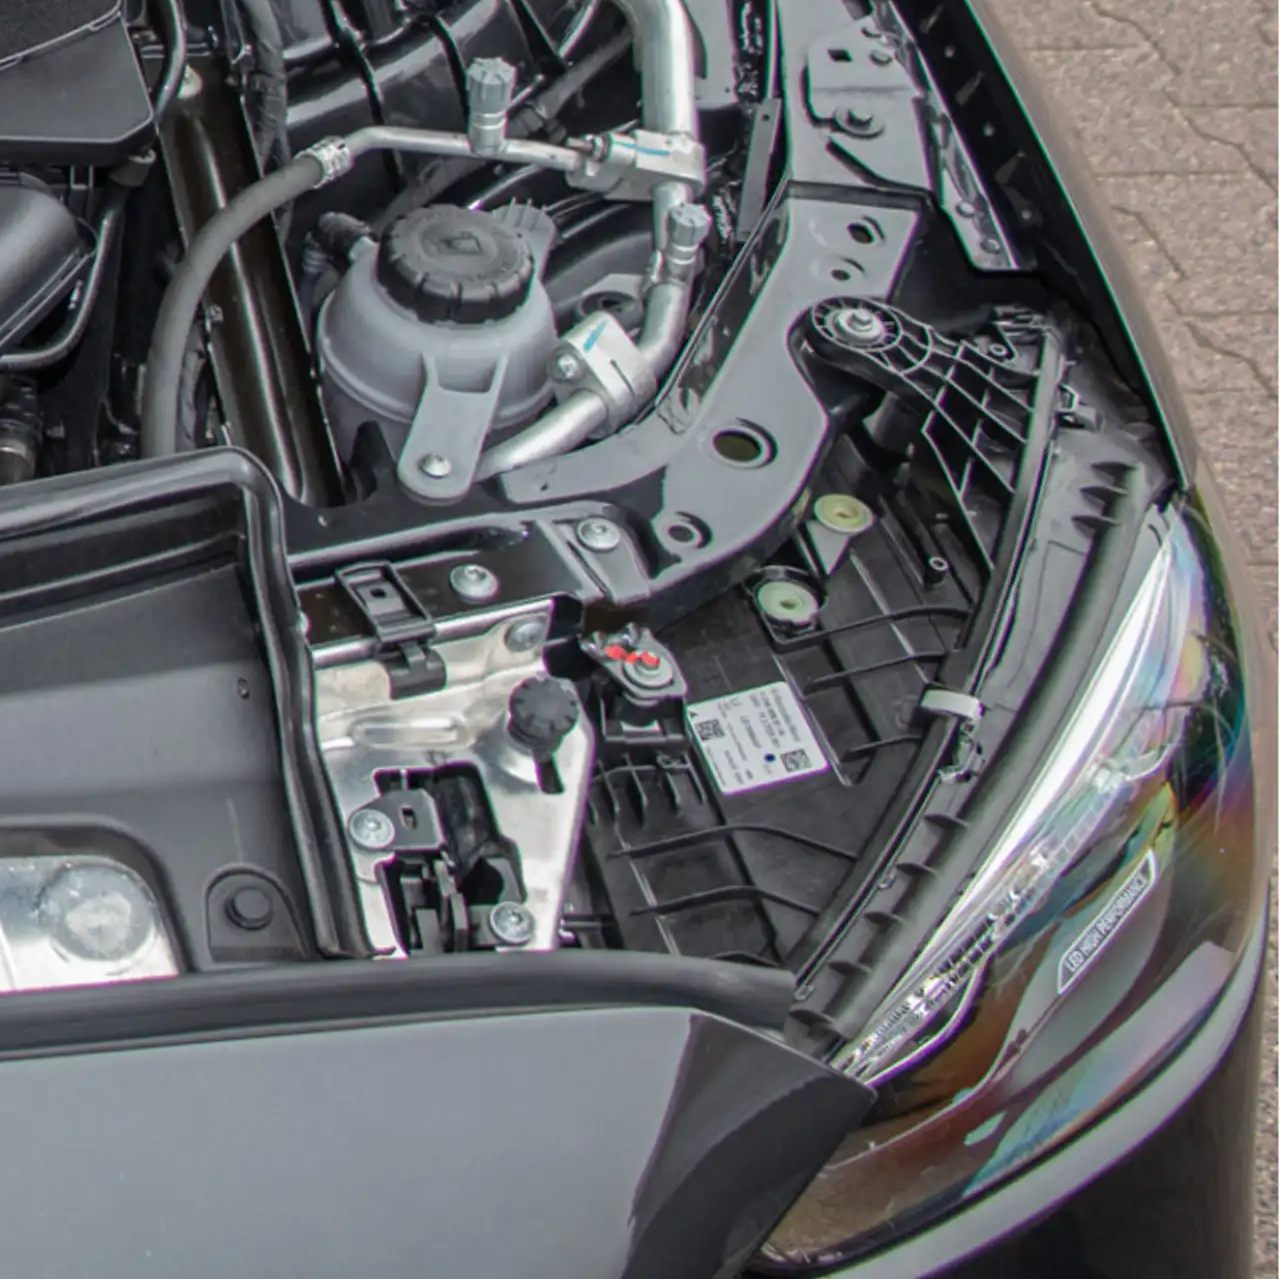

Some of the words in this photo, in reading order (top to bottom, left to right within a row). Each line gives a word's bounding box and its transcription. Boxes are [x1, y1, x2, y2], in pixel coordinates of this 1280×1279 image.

[1062, 949, 1086, 973] LED
[1077, 928, 1104, 956] HIGH
[1094, 873, 1150, 935] PERFORMANCE
